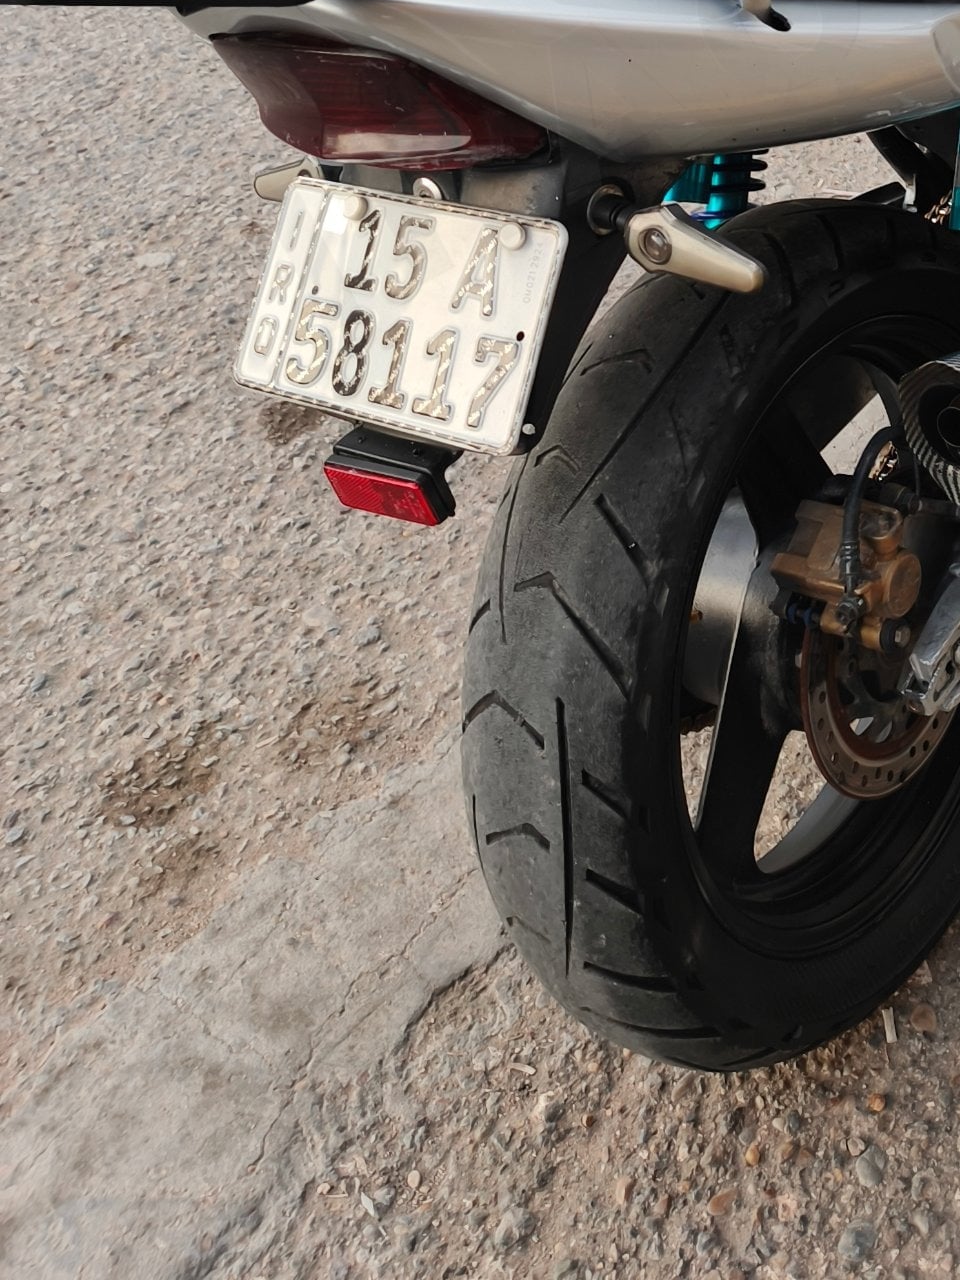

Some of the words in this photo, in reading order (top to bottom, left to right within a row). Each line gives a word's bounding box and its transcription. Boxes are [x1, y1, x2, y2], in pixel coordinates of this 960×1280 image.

[344, 208, 434, 300] 15
[451, 227, 499, 317] A
[284, 298, 520, 428] 58117
